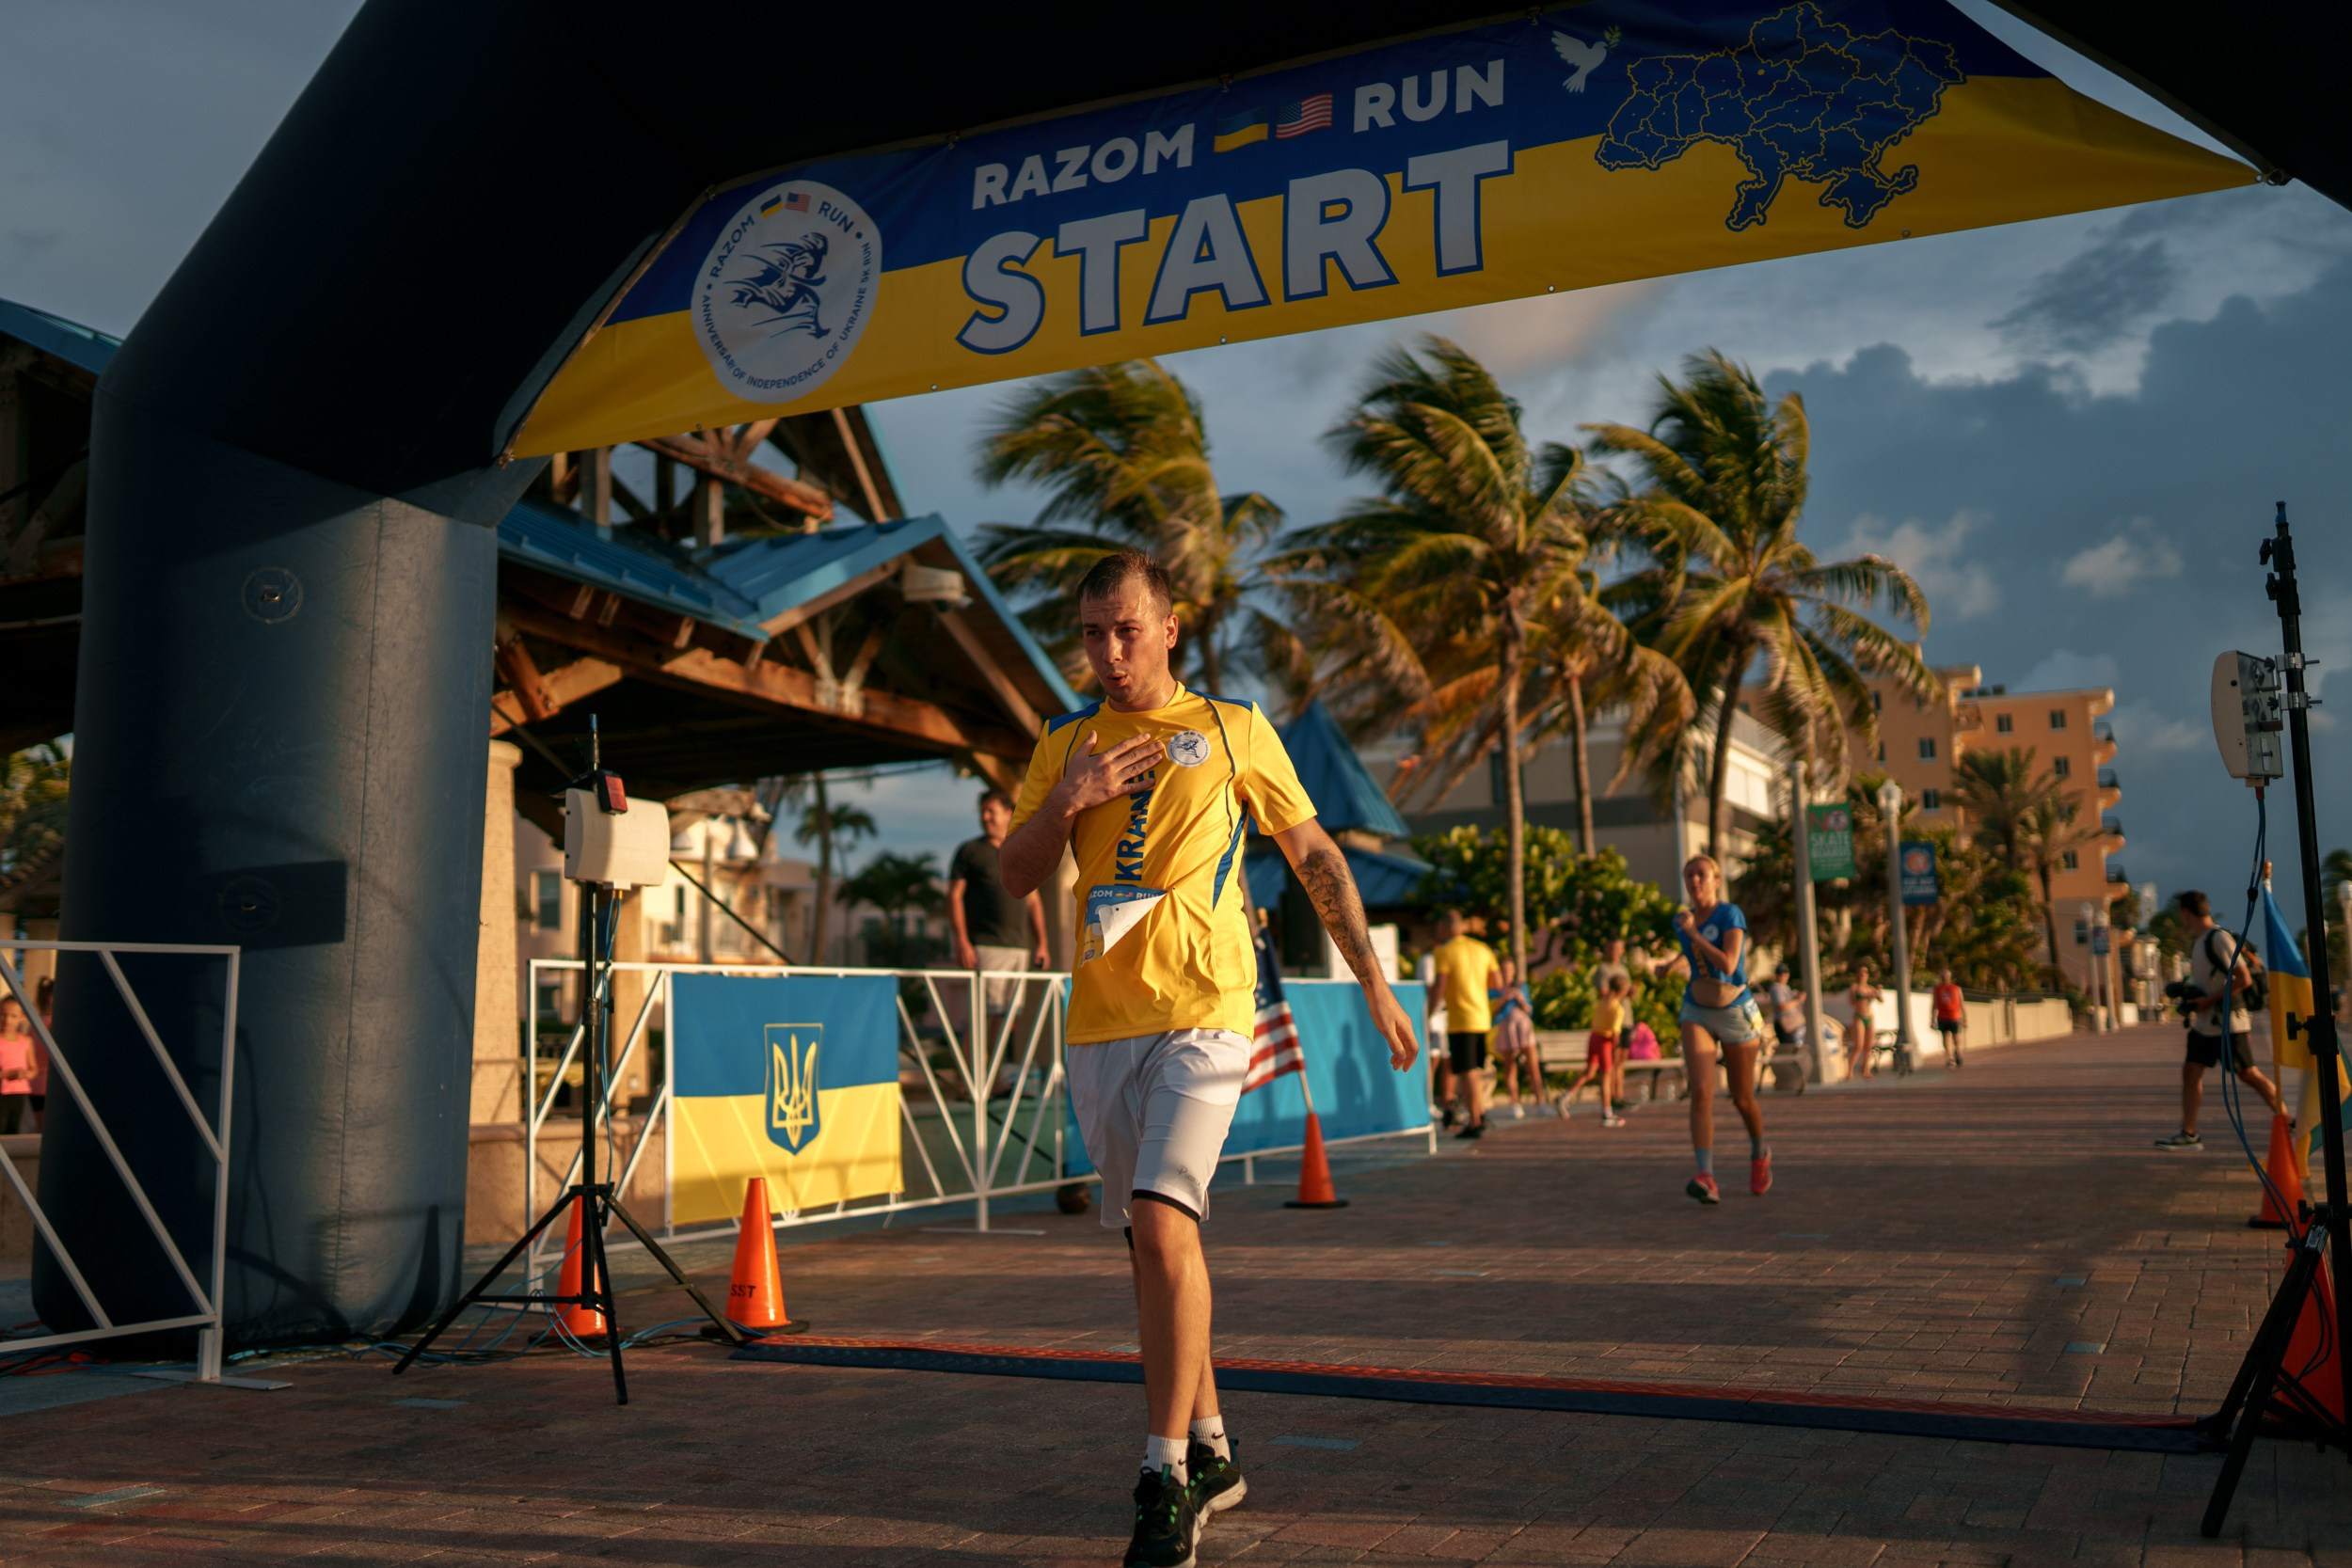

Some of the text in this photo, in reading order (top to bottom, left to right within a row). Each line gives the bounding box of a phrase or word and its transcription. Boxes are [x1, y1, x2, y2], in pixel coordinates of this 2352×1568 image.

[972, 58, 1504, 210] RAZOM RUN
[710, 200, 854, 278] RAZOM RUN
[956, 140, 1515, 355] START
[732, 367, 747, 380] OF
[746, 358, 826, 389] INDEPENDENCE
[826, 341, 841, 360] OF
[840, 286, 867, 341] UKRAINE
[861, 241, 872, 267] RUN
[1114, 770, 1155, 888] KRAINE
[1089, 890, 1113, 900] ZOM
[730, 1283, 756, 1299] SST
